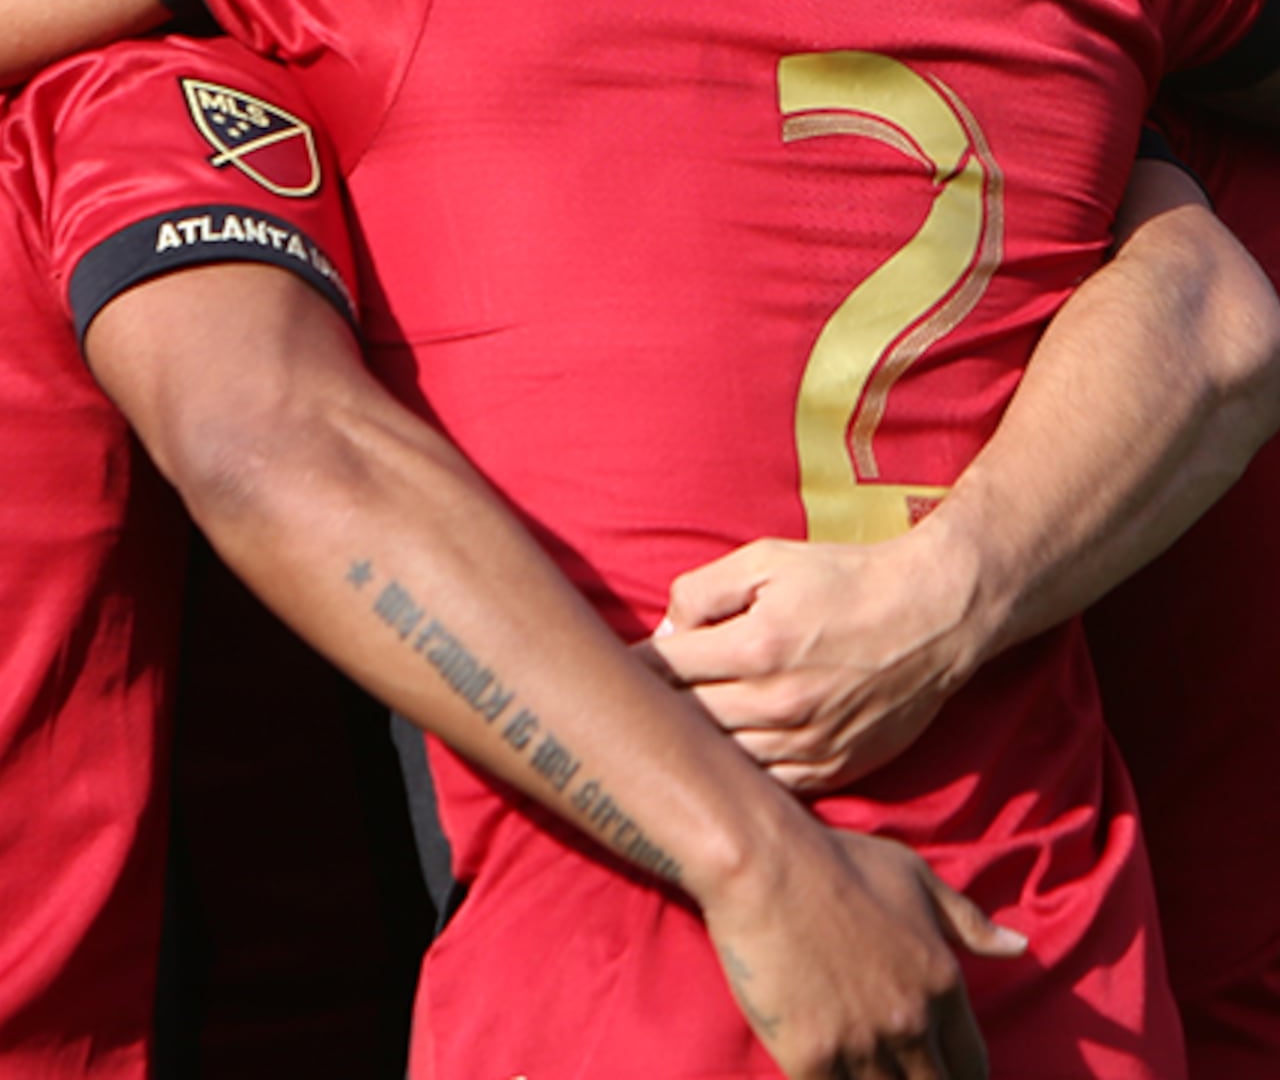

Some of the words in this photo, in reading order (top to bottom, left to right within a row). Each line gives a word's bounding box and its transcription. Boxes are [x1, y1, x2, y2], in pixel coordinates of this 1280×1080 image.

[198, 89, 271, 128] MLS
[155, 215, 307, 260] ATLANTA
[777, 50, 1005, 543] 2
